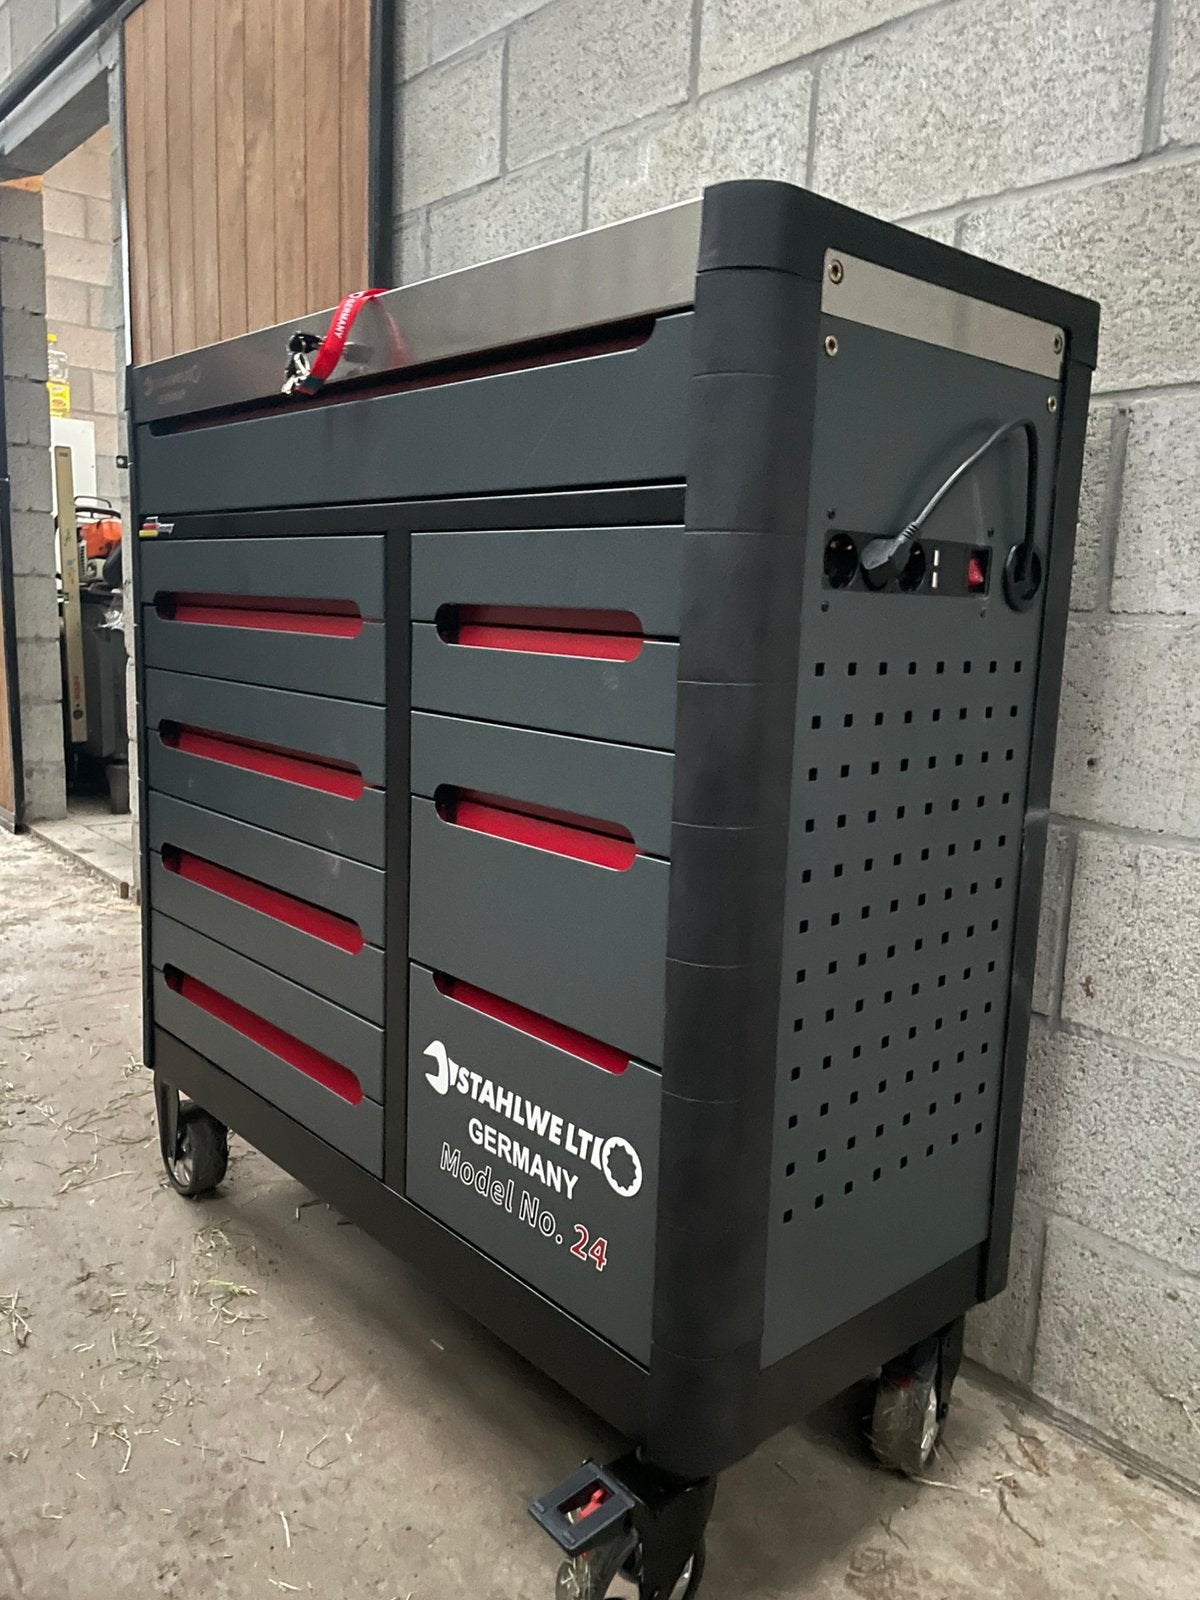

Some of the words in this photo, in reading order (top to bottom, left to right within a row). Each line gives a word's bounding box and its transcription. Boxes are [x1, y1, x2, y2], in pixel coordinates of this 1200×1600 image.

[334, 298, 356, 339] GERMANY
[455, 1067, 595, 1161] STAHLWELT
[468, 1117, 579, 1200] GERMANY
[439, 1142, 515, 1213] Model
[519, 1190, 564, 1245] No.
[570, 1223, 608, 1272] 24
